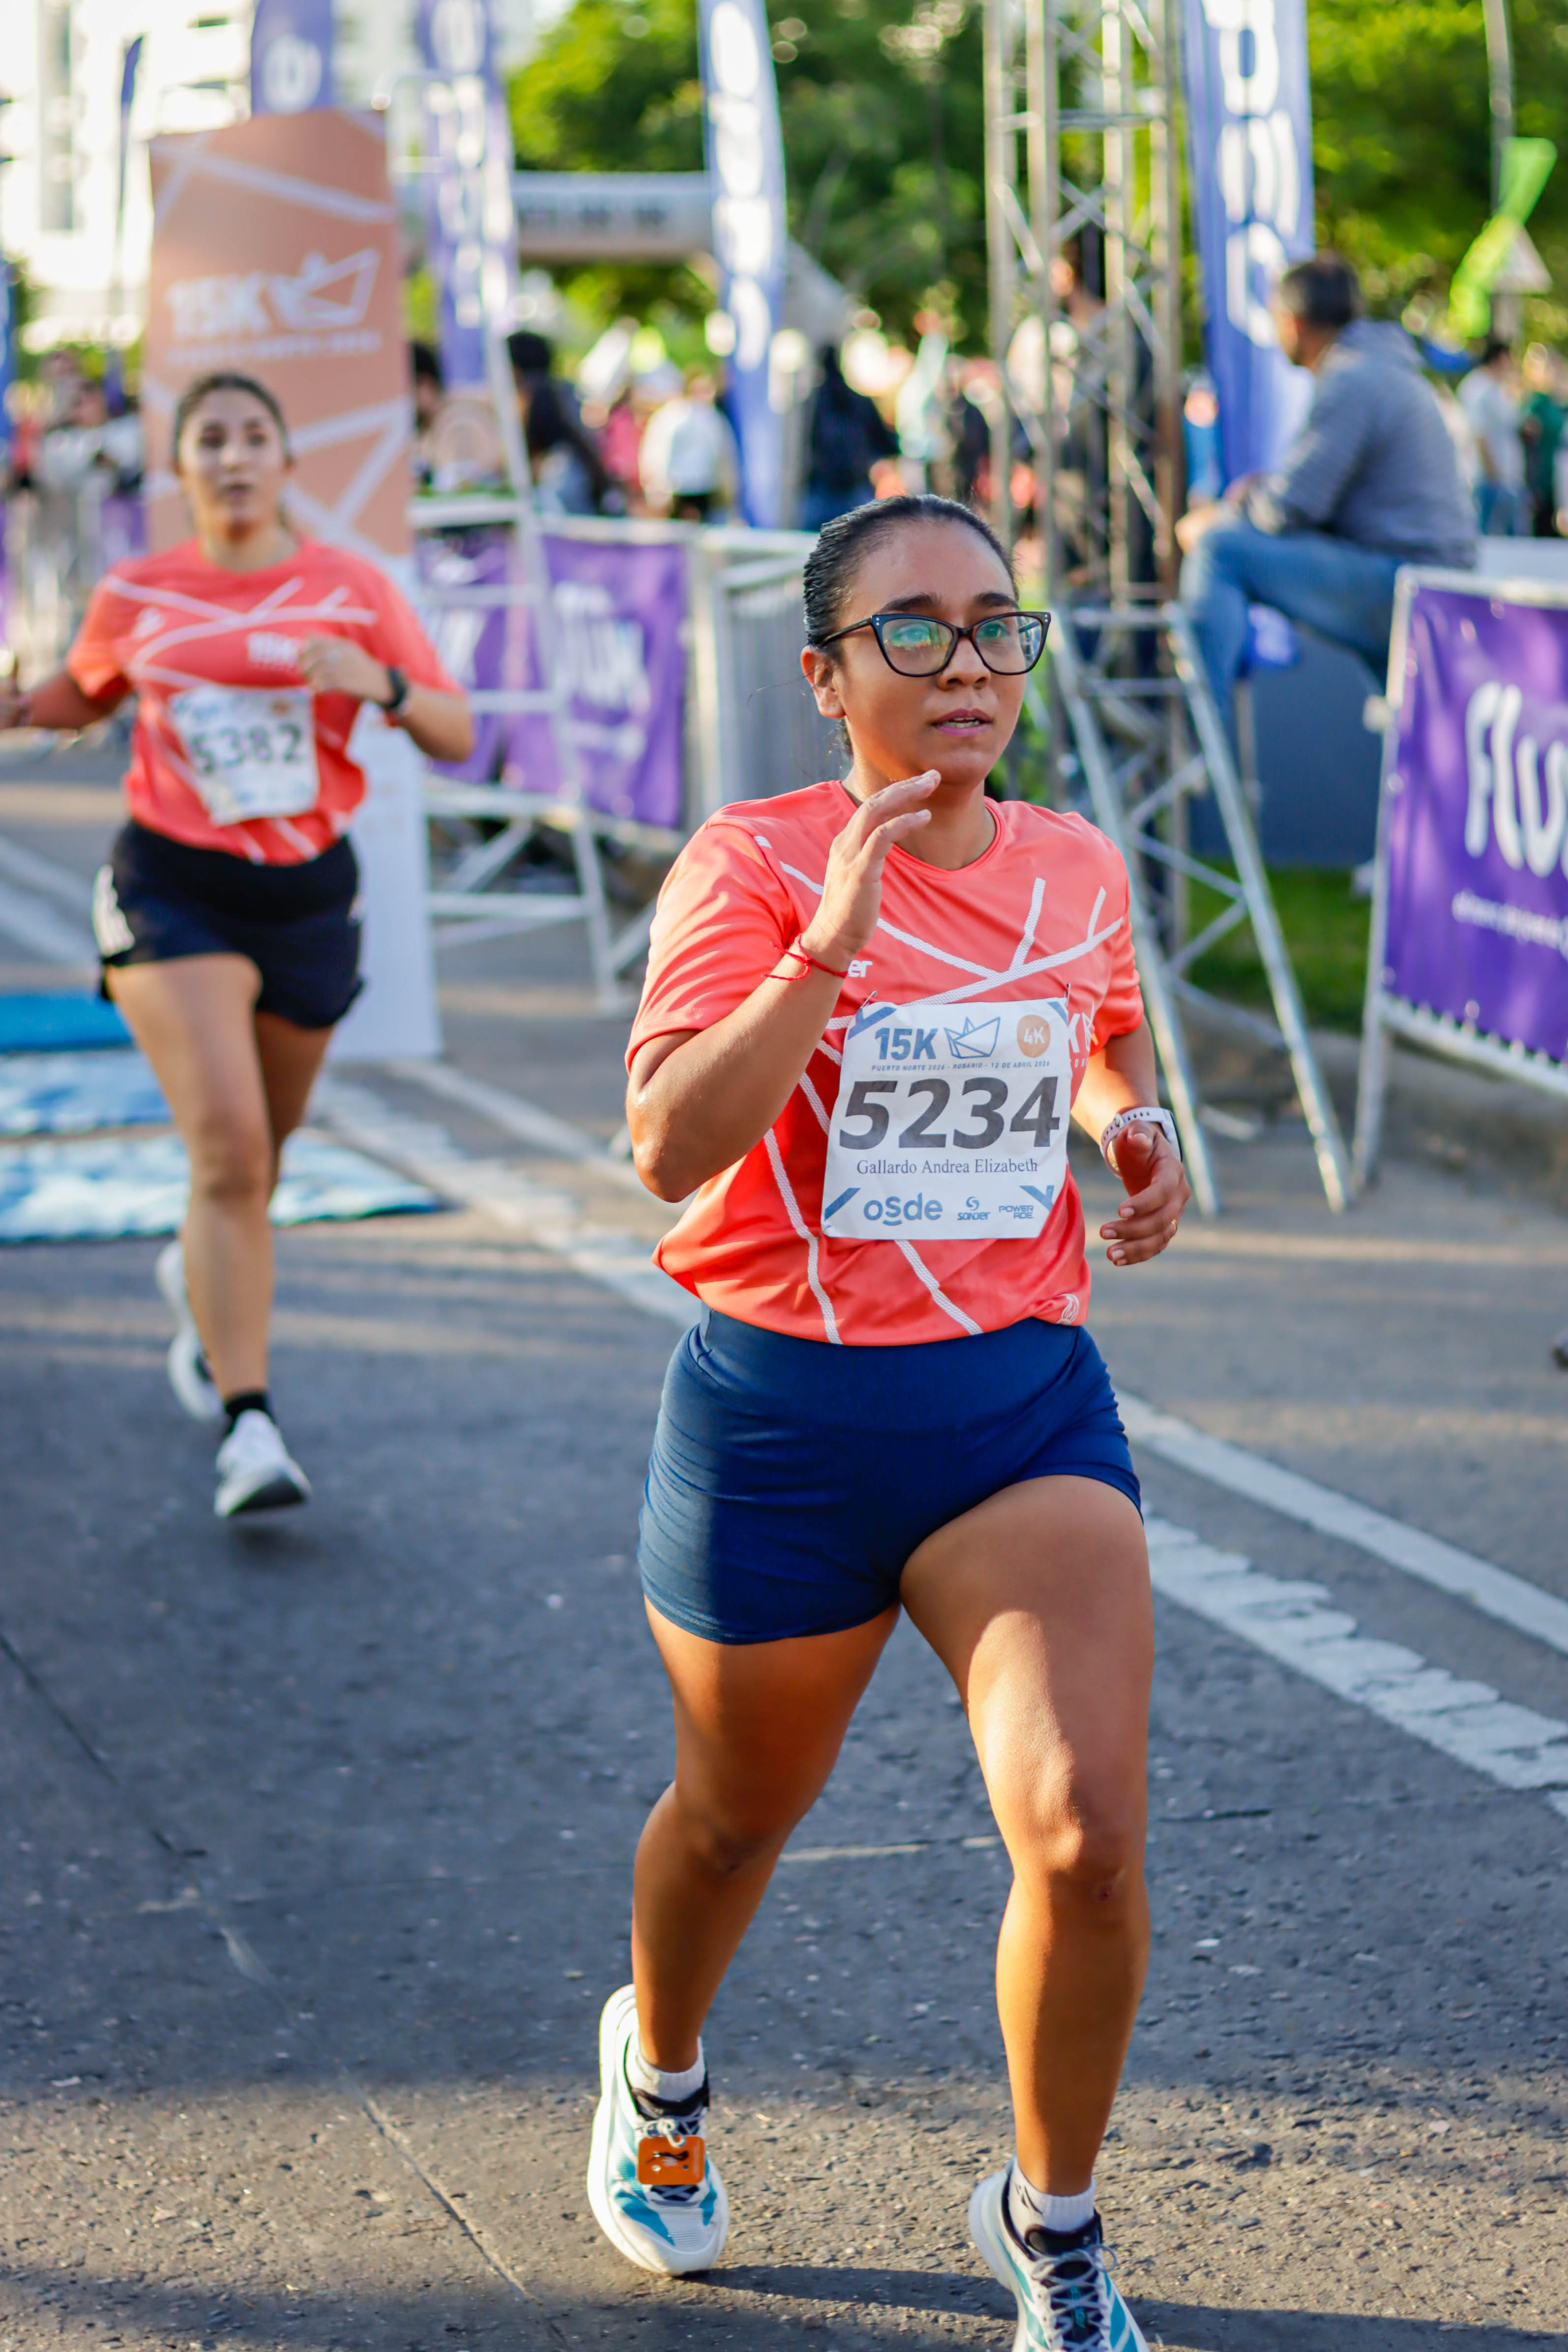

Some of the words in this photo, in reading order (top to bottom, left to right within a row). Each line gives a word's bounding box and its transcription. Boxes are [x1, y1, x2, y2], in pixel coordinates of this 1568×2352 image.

[191, 723, 305, 776] 5382
[875, 1027, 939, 1060] 15K
[1023, 1027, 1045, 1045] 4K
[839, 1076, 1060, 1150] 5234
[857, 1159, 917, 1174] Gallardo
[921, 1159, 970, 1174] Andrea
[975, 1158, 1038, 1173] Elizabeth
[863, 1192, 943, 1221] osde
